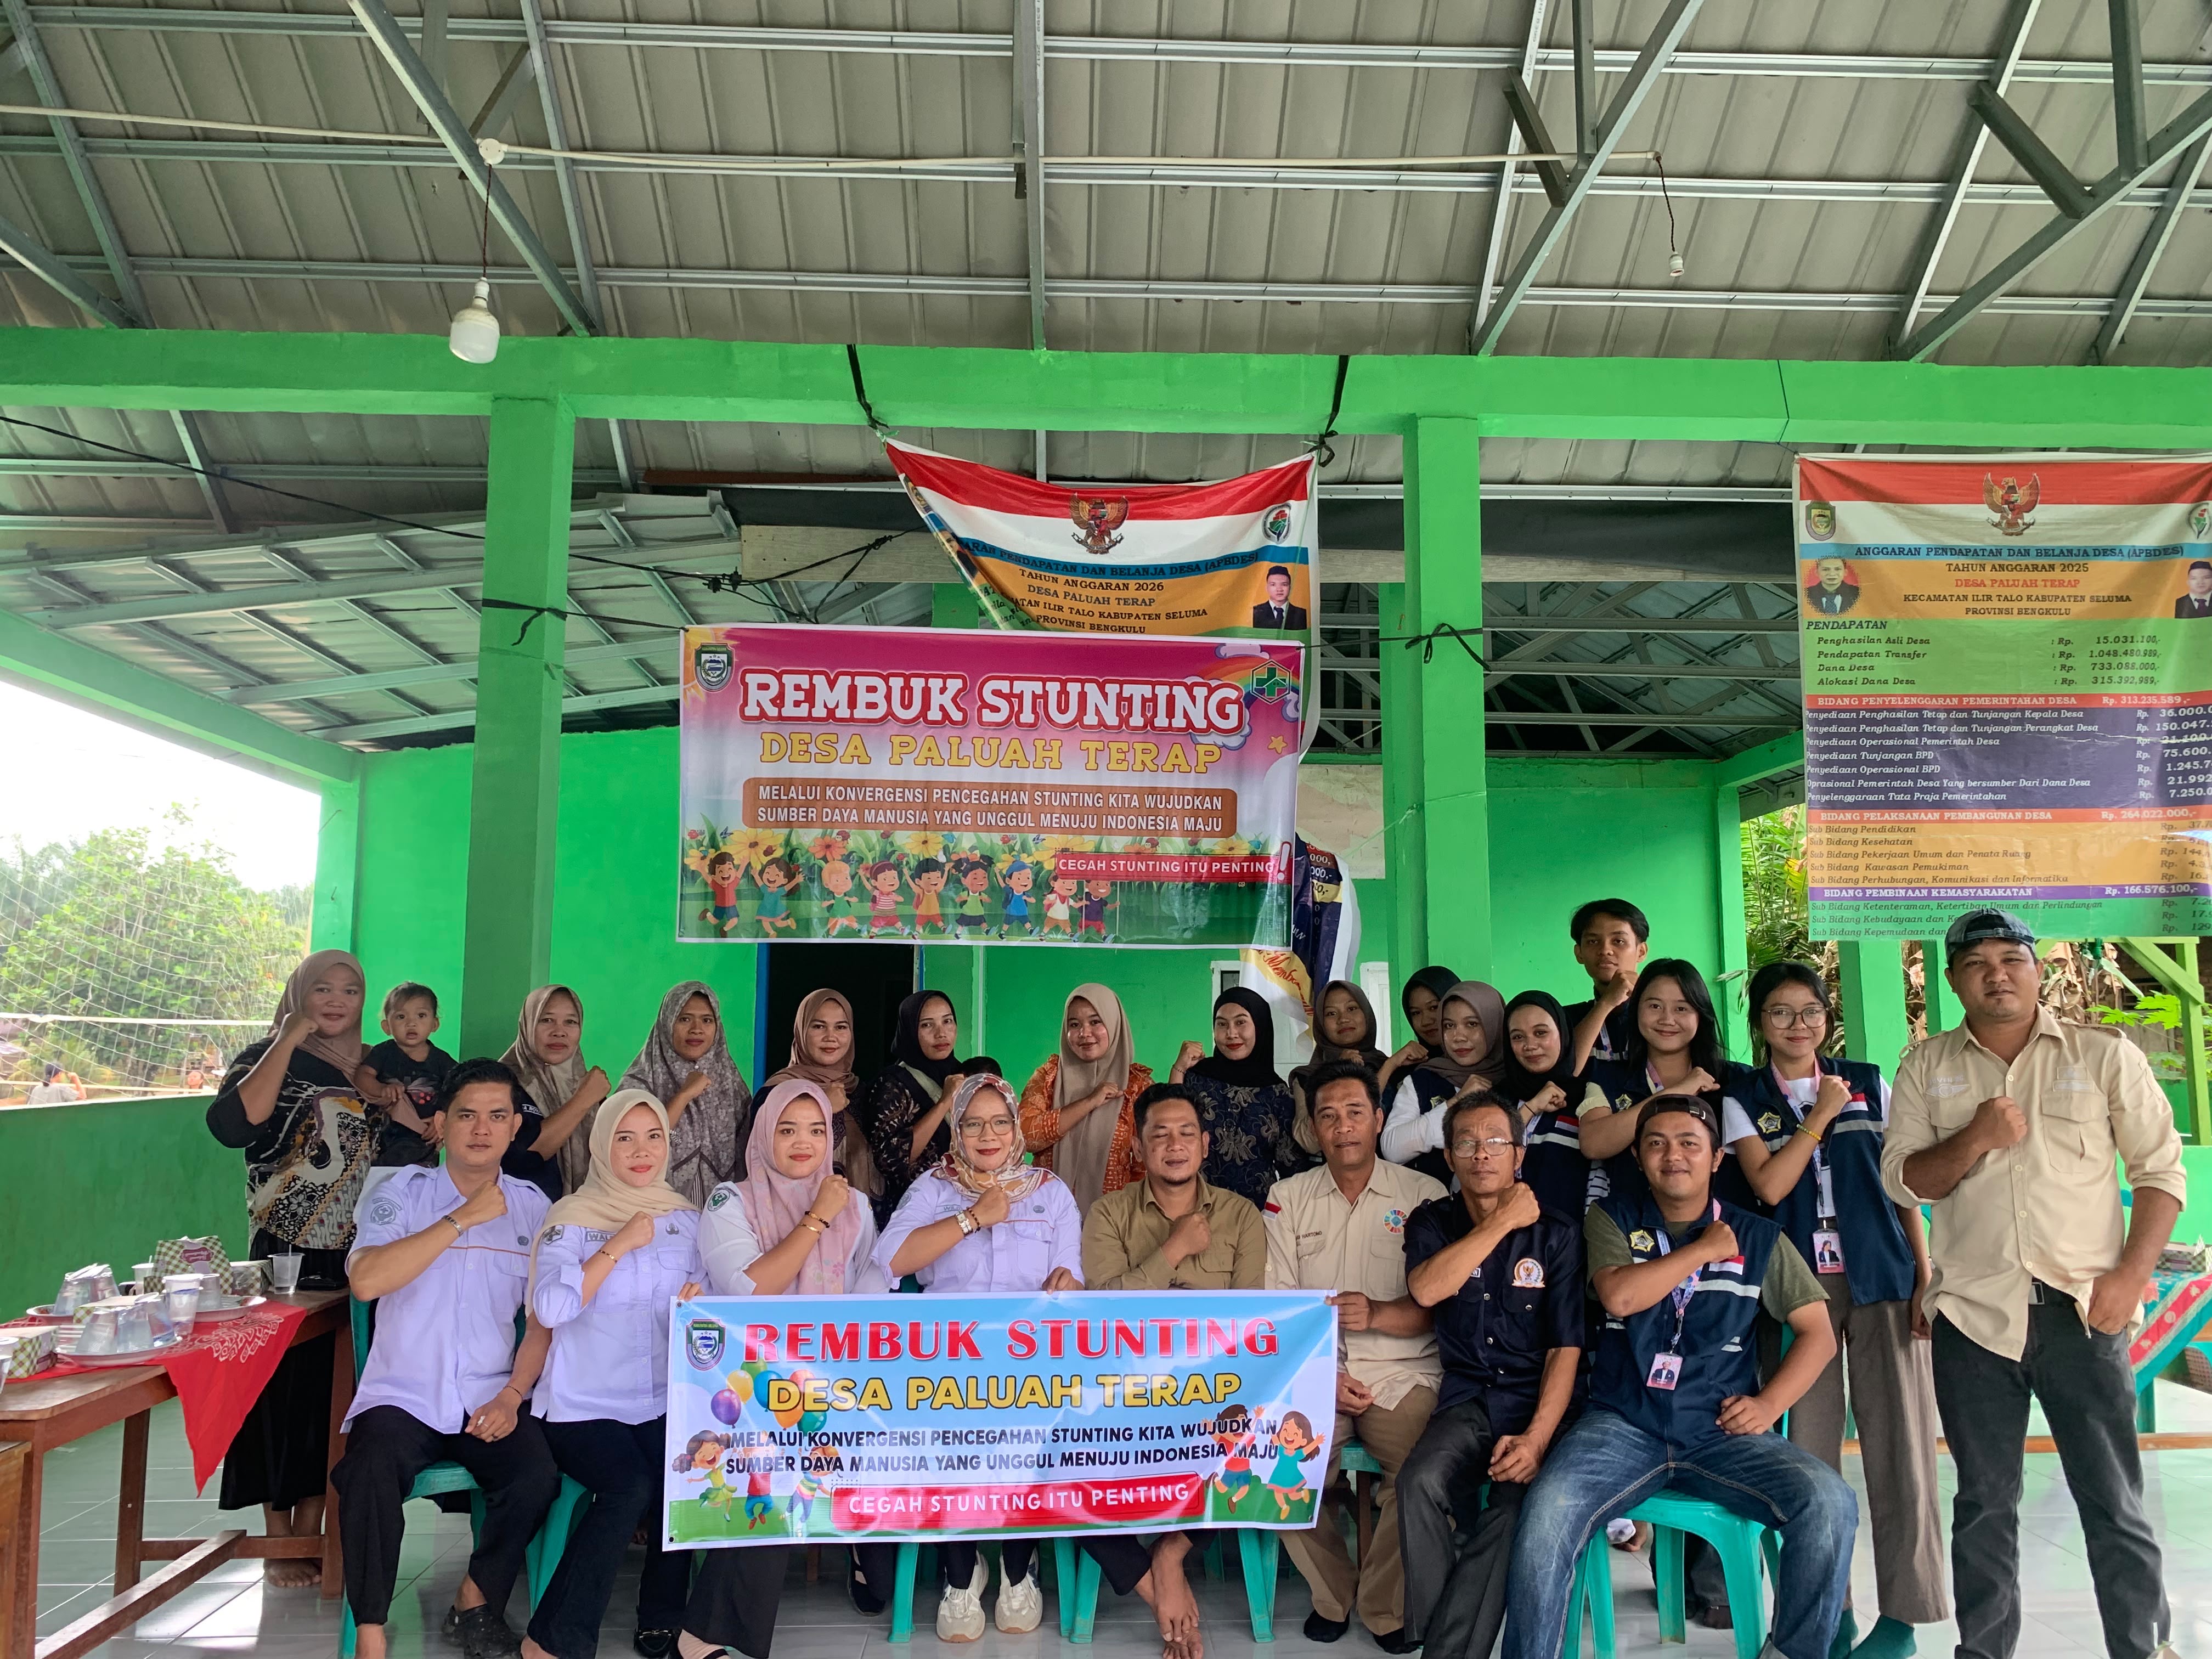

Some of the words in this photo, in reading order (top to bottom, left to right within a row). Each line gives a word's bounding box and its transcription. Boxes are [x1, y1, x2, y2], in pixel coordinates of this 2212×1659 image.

[1855, 547, 1921, 556] ANGGARAN
[1926, 548, 2002, 557] PENDAPATAN
[2007, 549, 2030, 557] DAN
[2035, 549, 2089, 557] BELANJA
[2093, 549, 2124, 557] DESA
[1000, 550, 1076, 572] PENDAPATAN
[1082, 566, 1105, 575] DAN
[1110, 566, 1165, 576] BELANJA
[1170, 563, 1201, 575] DESA
[1205, 552, 1258, 572] (APBDES)
[1946, 563, 1986, 572] TAHUN
[1990, 564, 2055, 572] ANGGARAN
[2060, 563, 2089, 572] 2025
[1019, 569, 1059, 584] TAHUN
[1064, 578, 1130, 591] ANGGARAN
[1134, 582, 1164, 591] 2026
[1955, 579, 1986, 588] DESA
[1990, 579, 2038, 588] PALUAH
[2041, 579, 2080, 588] TERAP
[1028, 584, 1059, 598] DESA
[1064, 591, 1110, 605] PALUAH
[1115, 597, 1155, 607] TERAP
[1043, 603, 1065, 613] ILIR
[1068, 607, 1094, 618] TALO
[1098, 611, 1161, 620] KABUPATEN
[1165, 608, 1207, 620] SELUMA
[1036, 614, 1085, 629] PROVINSI
[1089, 623, 1146, 634] BENGKULU
[1806, 620, 1887, 629] PENDAPATAN
[1818, 636, 1882, 646] Penghasilan
[2057, 638, 2073, 646] Rp.
[1818, 651, 1880, 659] Pendapatan
[1885, 651, 1927, 659] Transfer
[2058, 651, 2075, 659] Rp.
[2060, 664, 2076, 672] Rp.
[2061, 678, 2076, 686] Rp.
[743, 671, 966, 723] REMBUK
[982, 679, 1241, 731] STUNTING
[2102, 696, 2117, 706] Rp.
[1859, 710, 1918, 720] Penghasilan
[1922, 710, 1947, 719] Tetap
[1972, 710, 2021, 719] Tunjangan
[2025, 710, 2058, 719] Kepala
[760, 732, 871, 765] DESA
[889, 735, 1062, 770] PALUAH
[1080, 740, 1223, 773] TERAP
[1808, 780, 1855, 788] Oprasional
[1943, 779, 1964, 788] Yang
[758, 784, 821, 800] MELALUI
[825, 786, 928, 804] KONVERGENSI
[933, 788, 1029, 805] PENCEGAHAN
[1034, 791, 1104, 808] STUNTING
[1108, 792, 1140, 808] KITA
[1143, 793, 1222, 810] WUJUDKAN
[757, 806, 817, 823] SUMBER
[822, 808, 859, 824] DAYA
[863, 809, 928, 826] MANUSIA
[934, 810, 972, 826] YANG
[977, 811, 1035, 828] UNGGUL
[1040, 813, 1098, 830] MENUJU
[1102, 814, 1179, 831] INDONESIA
[1183, 816, 1222, 832] MAJU
[1825, 826, 1858, 834] Bidang
[1826, 838, 1859, 847] Bidang
[1826, 850, 1857, 860] Bidang
[1862, 850, 1909, 860] Pekerjaan
[1058, 859, 1105, 873] CEGAH
[1109, 859, 1180, 873] STUNTING
[1184, 862, 1207, 873] ITU
[1931, 888, 2032, 897] KEMASYARAKATAN
[2105, 887, 2120, 896] Rp.
[743, 1319, 984, 1363] REMBUK
[1007, 1317, 1279, 1358] STUNTING
[768, 1378, 893, 1413] DESA
[907, 1375, 1083, 1410] PALUAH
[1096, 1373, 1242, 1406] TERAP
[731, 1431, 803, 1448] MELALUI
[808, 1430, 926, 1447] KONVERGENSI
[931, 1427, 1046, 1446] PENCEGAHAN
[1052, 1427, 1133, 1443] STUNTING
[1139, 1425, 1175, 1440] KITA
[1181, 1419, 1277, 1438] WUJUDKAN
[726, 1456, 795, 1474] SUMBER
[802, 1456, 844, 1472] DAYA
[850, 1455, 928, 1471] MANUSIA
[935, 1455, 981, 1471] YANG
[986, 1451, 1054, 1469] UNGGUL
[1060, 1451, 1130, 1467] MENUJU
[1135, 1443, 1228, 1464] INDONESIA
[1233, 1442, 1278, 1459] MAJU
[849, 1494, 922, 1515] CEGAH
[931, 1491, 1041, 1512] STUNTING
[1048, 1488, 1084, 1509] ITU
[1092, 1483, 1189, 1506] PENTING
